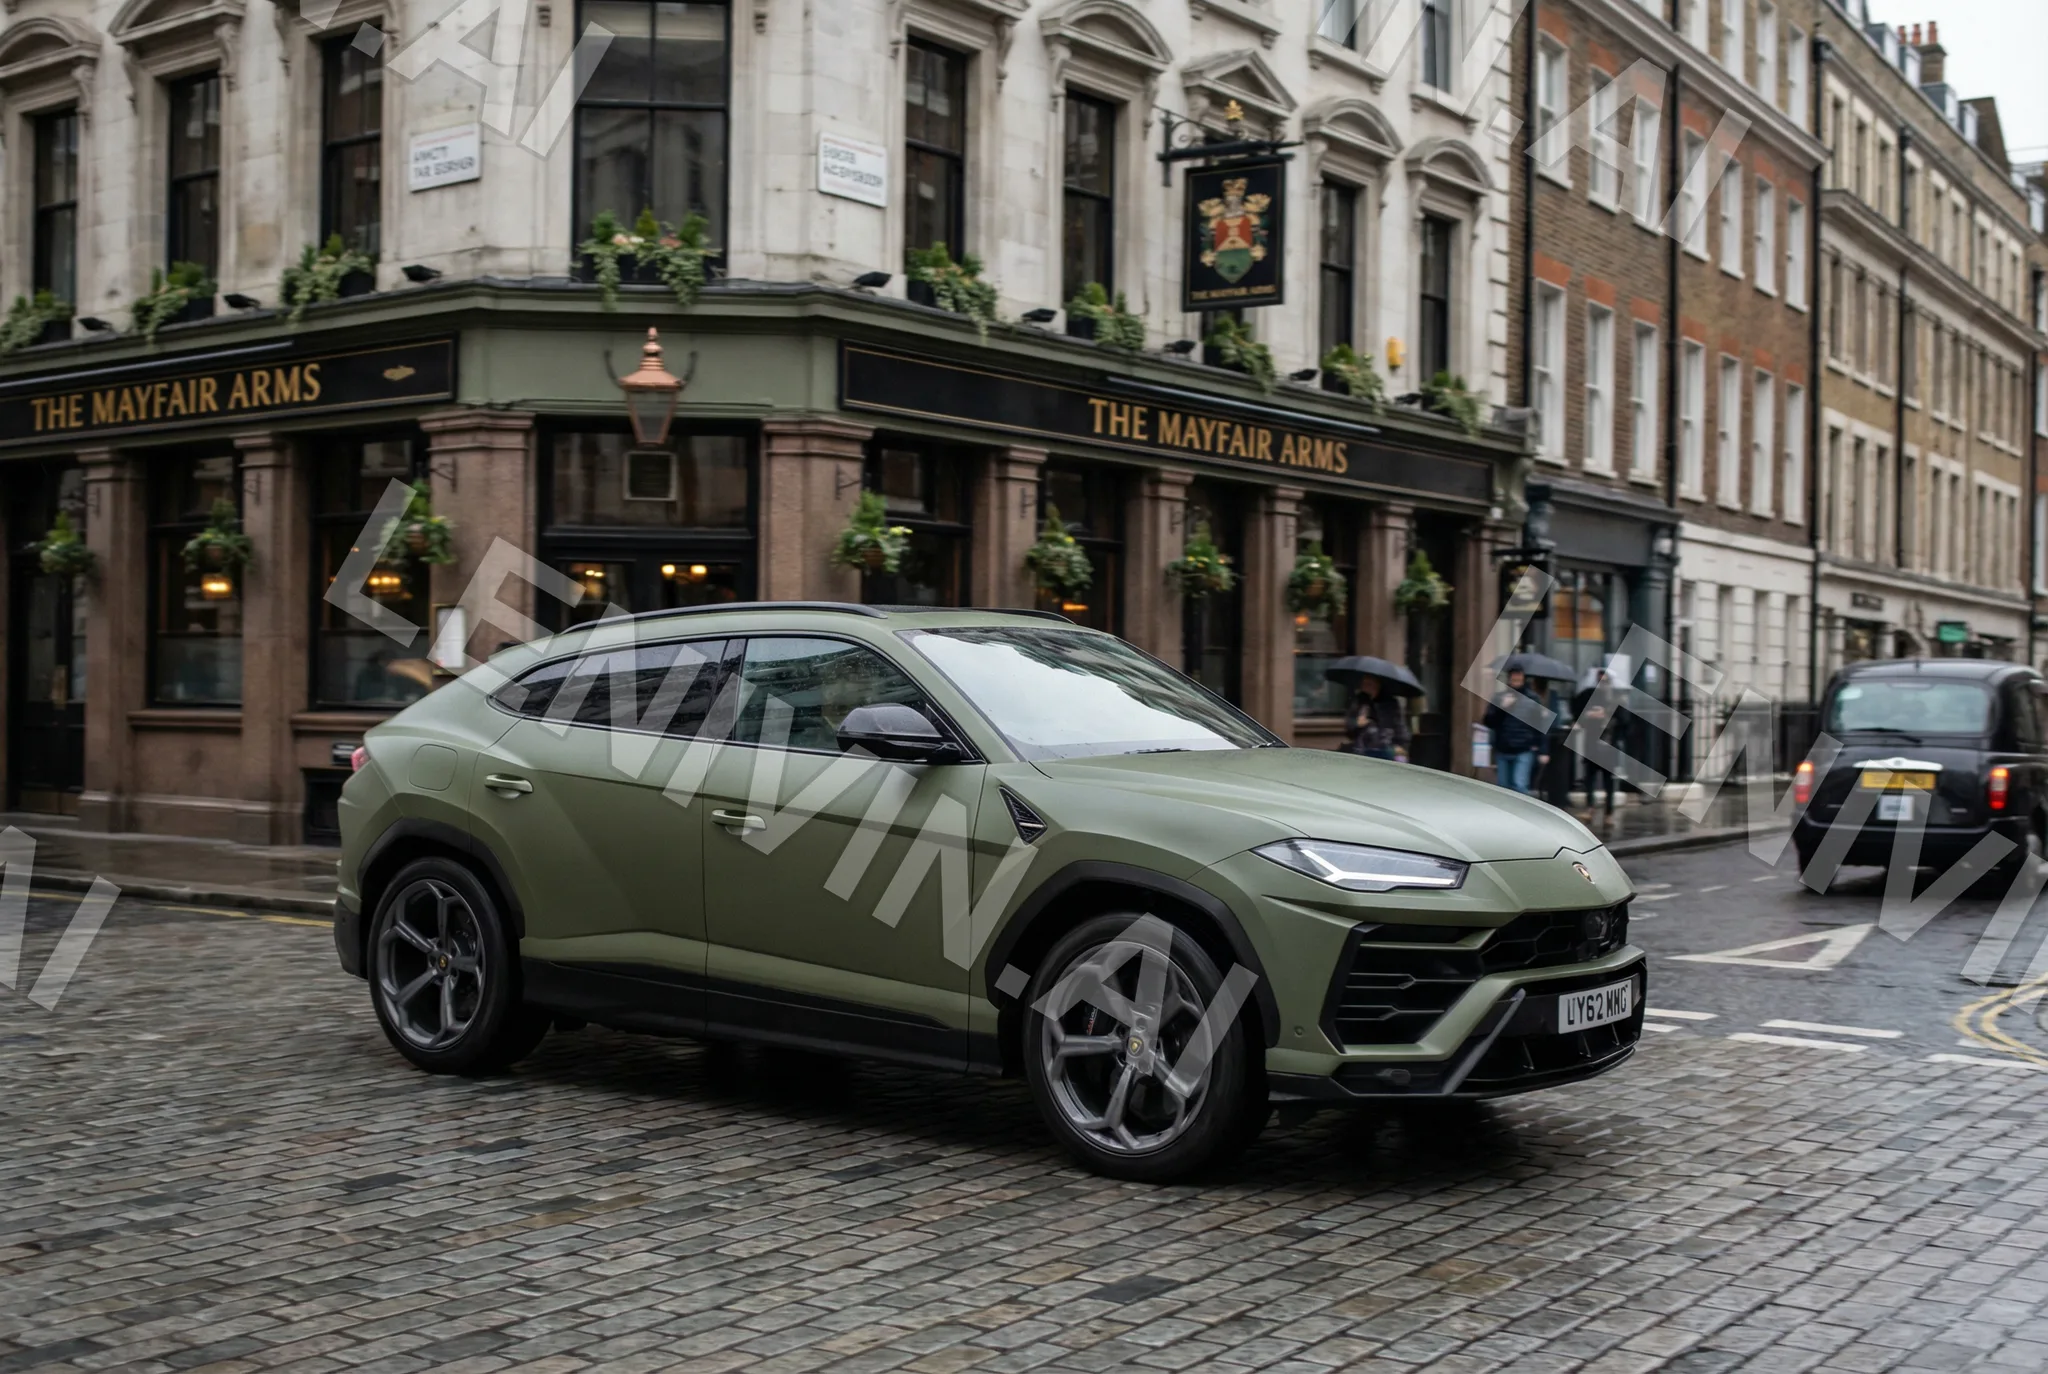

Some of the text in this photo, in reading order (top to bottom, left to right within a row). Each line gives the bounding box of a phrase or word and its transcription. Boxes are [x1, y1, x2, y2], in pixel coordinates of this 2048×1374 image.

[31, 363, 322, 431] THE MAYFAIR ARMS
[1088, 398, 1349, 474] THE MAYFAIR ARMS
